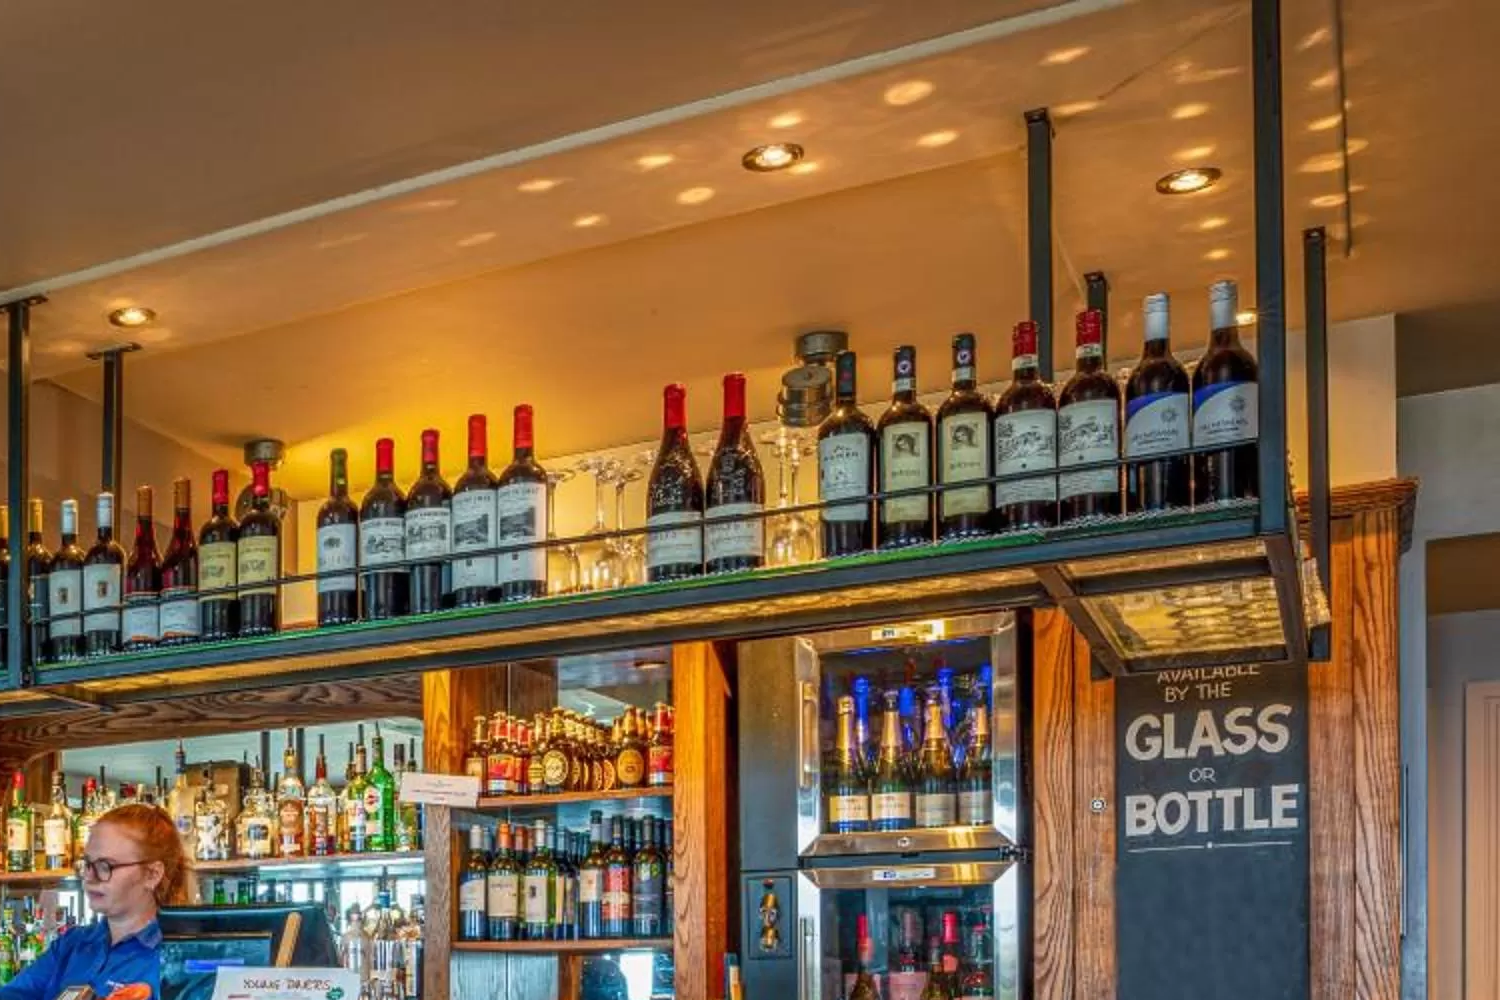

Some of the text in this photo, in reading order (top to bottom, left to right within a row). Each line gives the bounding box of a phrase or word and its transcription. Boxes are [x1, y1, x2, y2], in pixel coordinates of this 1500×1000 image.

[1156, 664, 1260, 683] AVAILABLE
[1164, 681, 1233, 703] BY THE
[1124, 703, 1293, 762] GLASS
[1189, 767, 1217, 783] OR
[1124, 783, 1300, 838] BOTTLE
